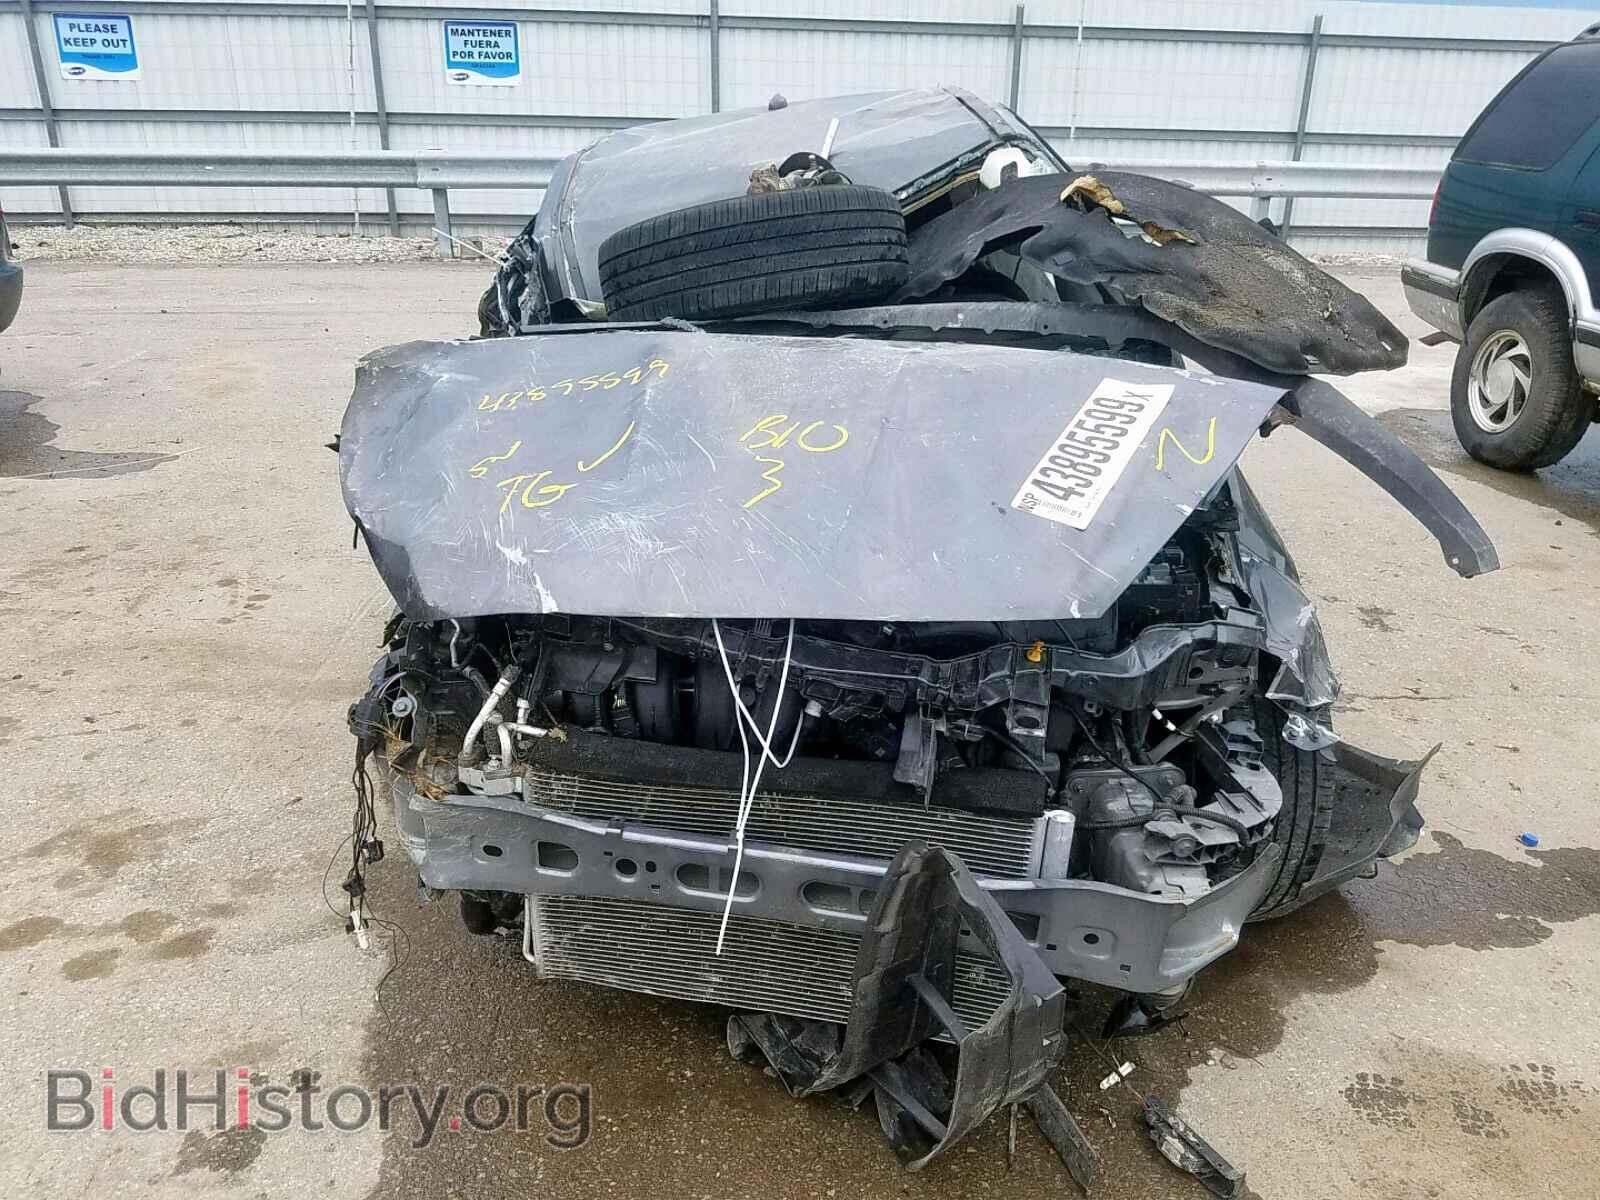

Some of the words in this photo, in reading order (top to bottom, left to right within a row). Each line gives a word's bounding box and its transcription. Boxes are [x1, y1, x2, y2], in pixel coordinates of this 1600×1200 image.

[68, 22, 119, 34] PLEASE
[450, 28, 512, 38] MANTENER
[63, 37, 97, 48] KEEP
[101, 38, 128, 49] OUT
[463, 39, 501, 49] FUERA
[452, 50, 474, 60] POR
[478, 51, 513, 60] FAVOR
[1031, 397, 1145, 501] 43895599
